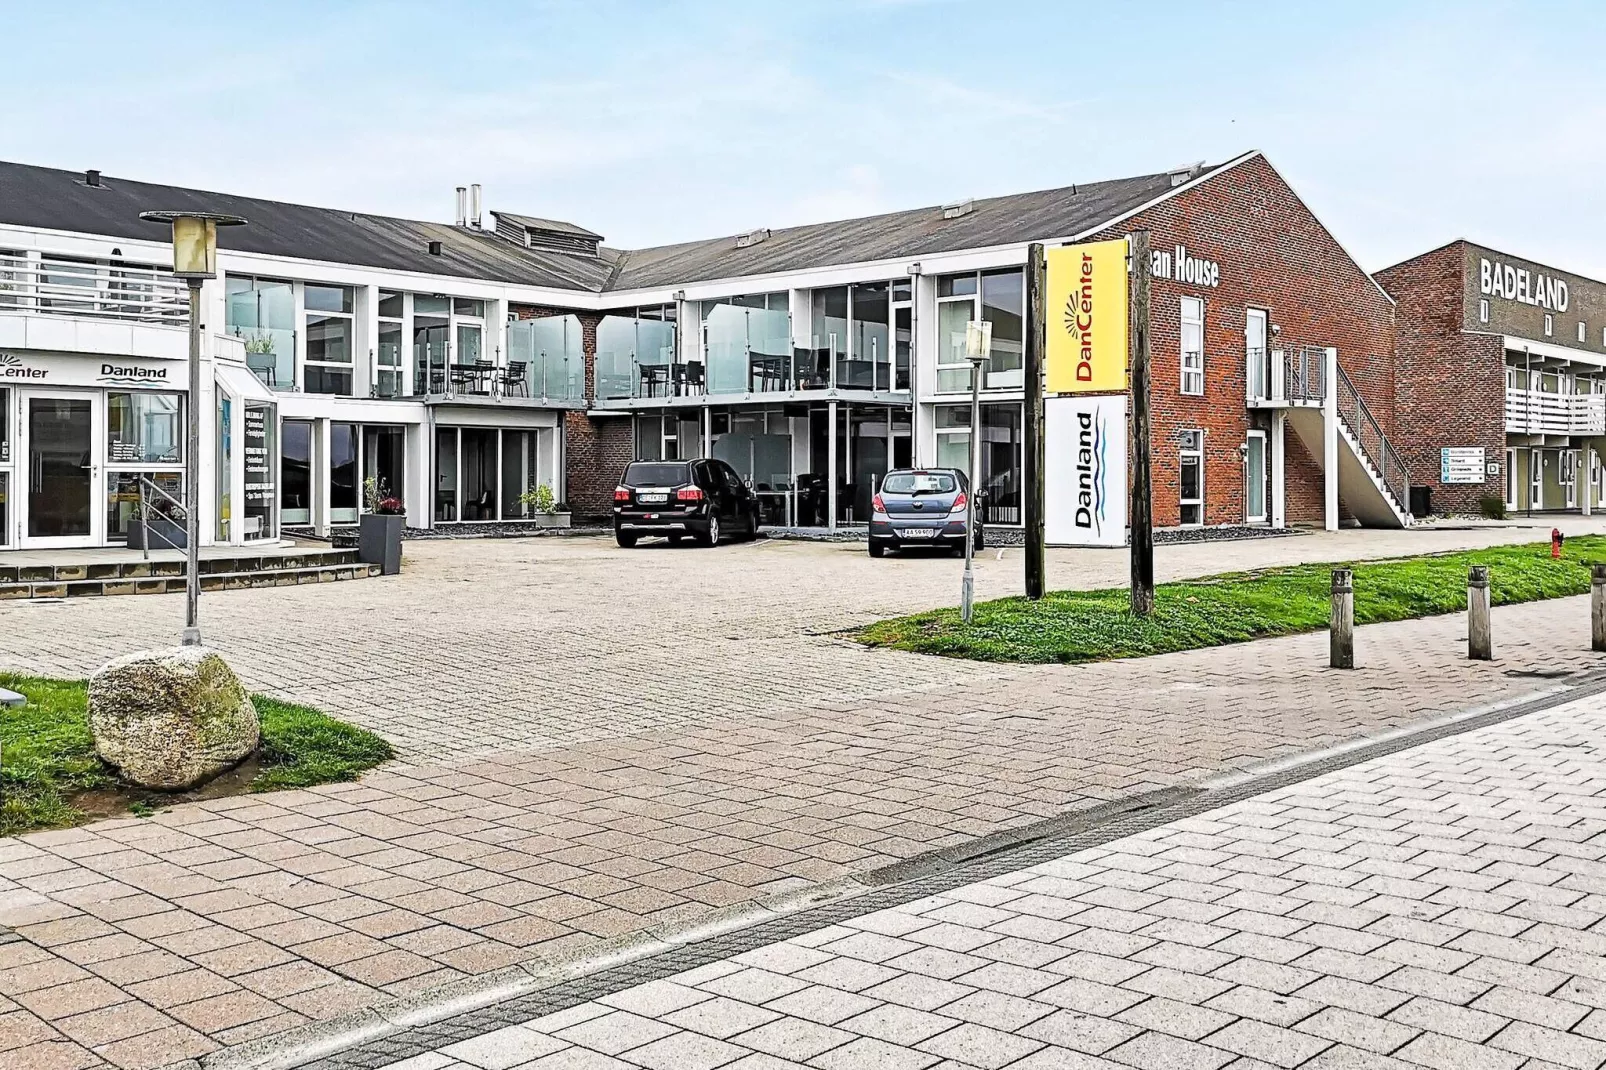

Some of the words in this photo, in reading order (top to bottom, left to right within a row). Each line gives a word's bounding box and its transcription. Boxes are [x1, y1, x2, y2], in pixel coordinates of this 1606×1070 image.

[1175, 244, 1219, 288] House
[1480, 257, 1569, 313] BADELAND
[1076, 252, 1093, 382] DanCenter
[101, 363, 167, 378] Danland
[1075, 412, 1092, 529] Danland
[1489, 465, 1497, 473] D
